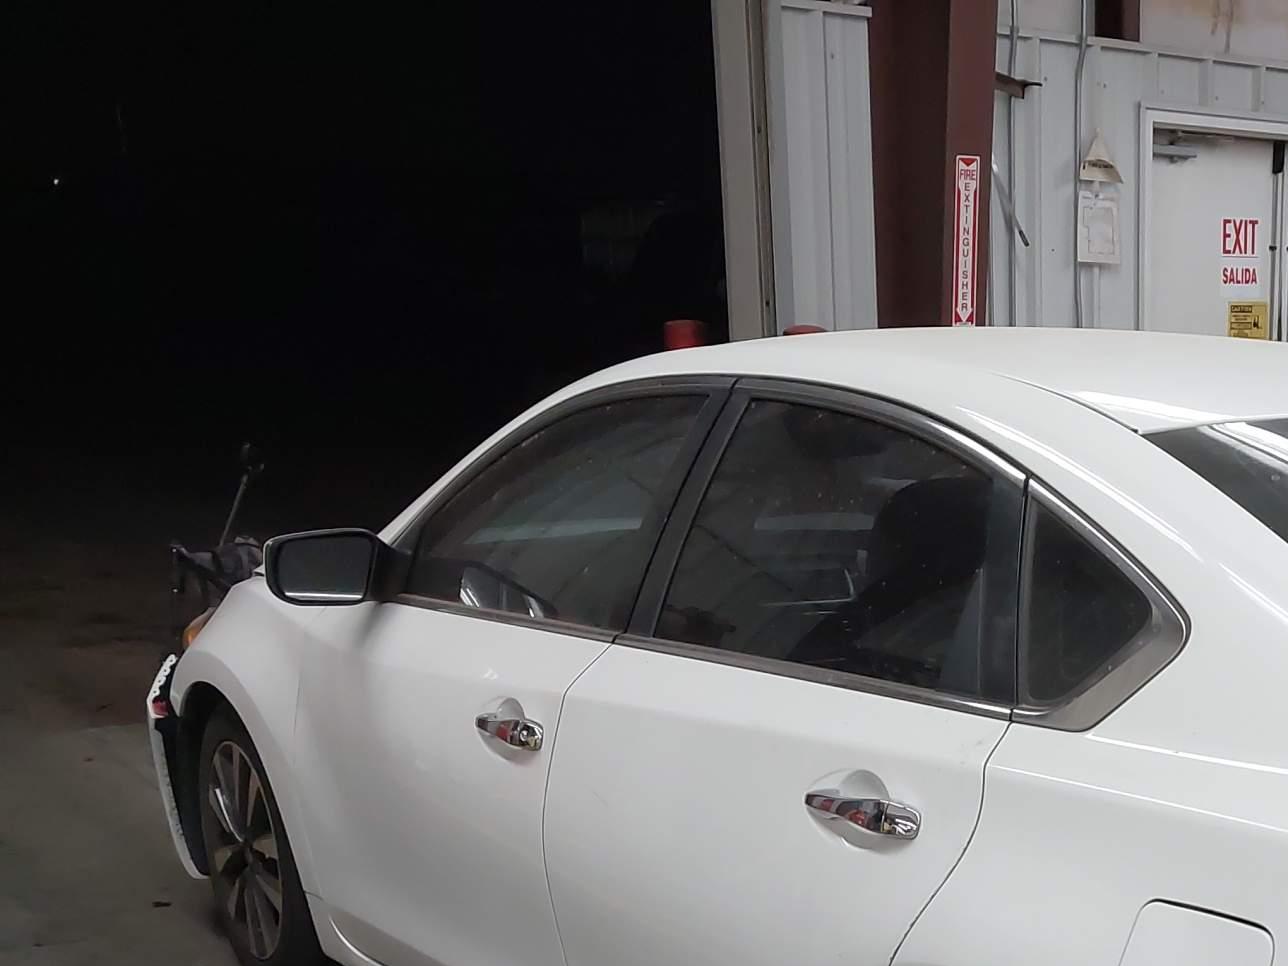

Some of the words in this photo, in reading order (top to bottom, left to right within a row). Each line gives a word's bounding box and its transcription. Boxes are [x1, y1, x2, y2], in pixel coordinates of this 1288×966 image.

[959, 168, 977, 181] FIRE
[960, 182, 971, 311] EXTINGUISHER
[1222, 218, 1259, 255] EXIT
[1222, 267, 1257, 285] SALIDA
